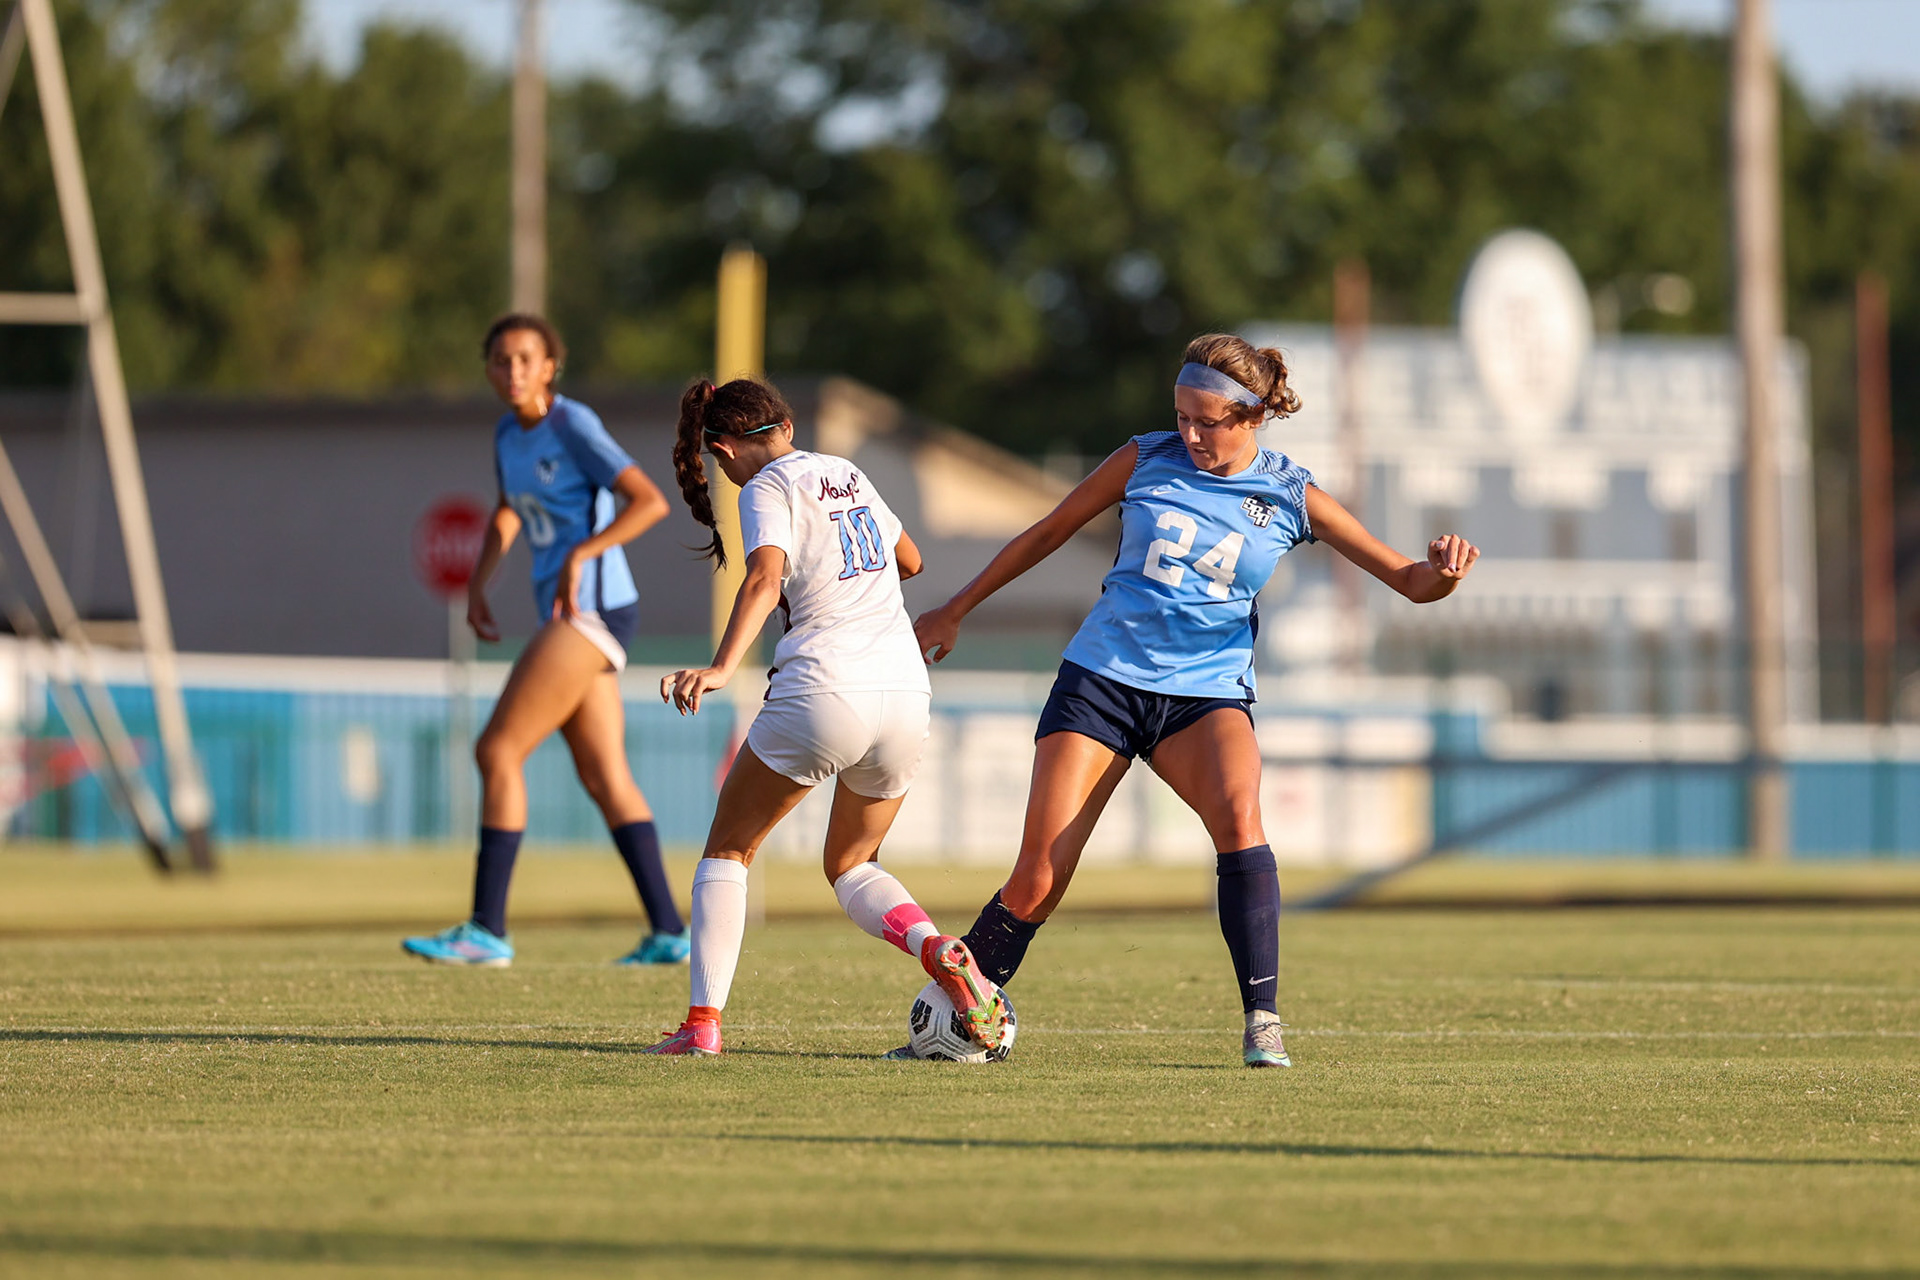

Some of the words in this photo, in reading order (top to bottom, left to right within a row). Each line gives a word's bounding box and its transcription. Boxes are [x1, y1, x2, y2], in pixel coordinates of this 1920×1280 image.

[829, 506, 887, 581] 10
[1241, 496, 1272, 528] SBA
[1142, 511, 1245, 601] 24
